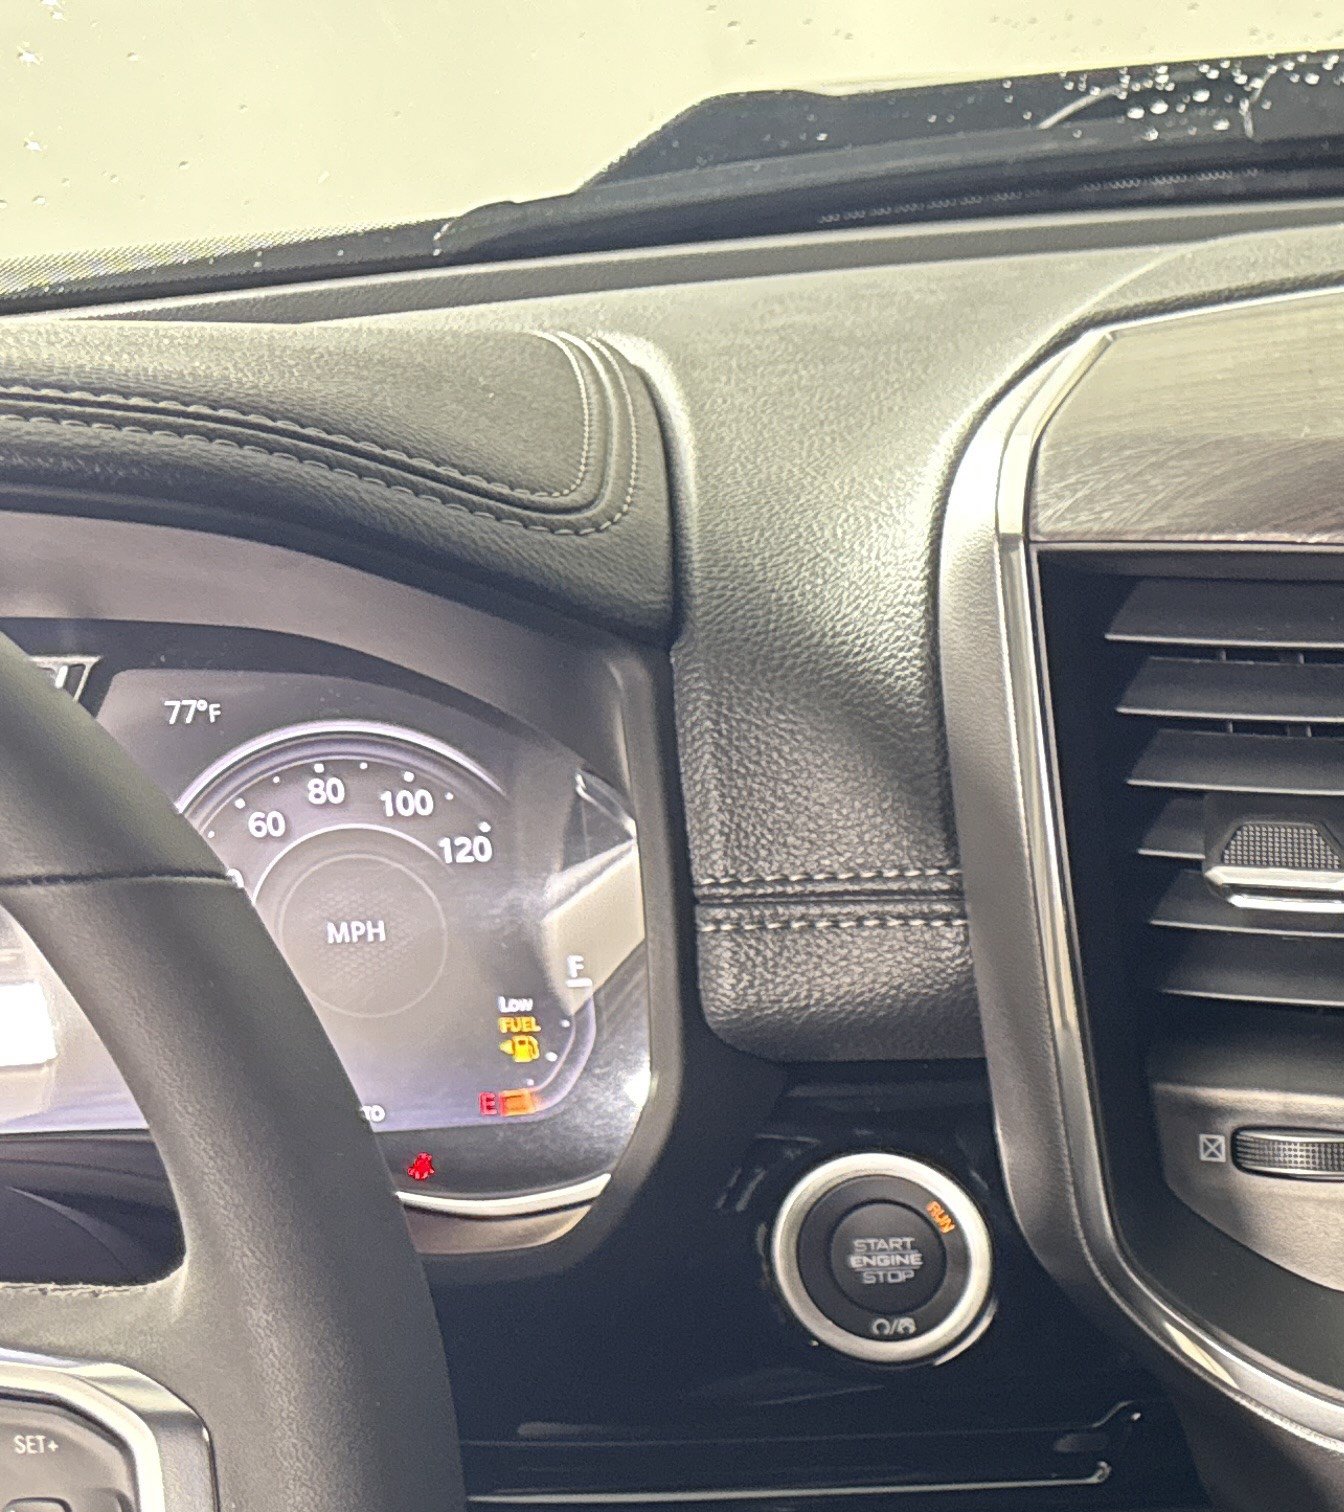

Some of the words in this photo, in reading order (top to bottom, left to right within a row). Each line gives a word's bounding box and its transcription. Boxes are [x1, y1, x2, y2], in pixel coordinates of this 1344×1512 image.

[307, 777, 345, 805] 80
[380, 789, 434, 817] 100
[248, 811, 285, 838] 60
[438, 835, 493, 864] 120
[326, 920, 386, 944] MPH
[567, 955, 585, 978] F
[498, 1016, 541, 1033] FUEL
[479, 1092, 497, 1115] E
[926, 1201, 955, 1233] RUN
[853, 1237, 915, 1252] START
[850, 1253, 922, 1268] ENGINE
[863, 1269, 915, 1284] STOP
